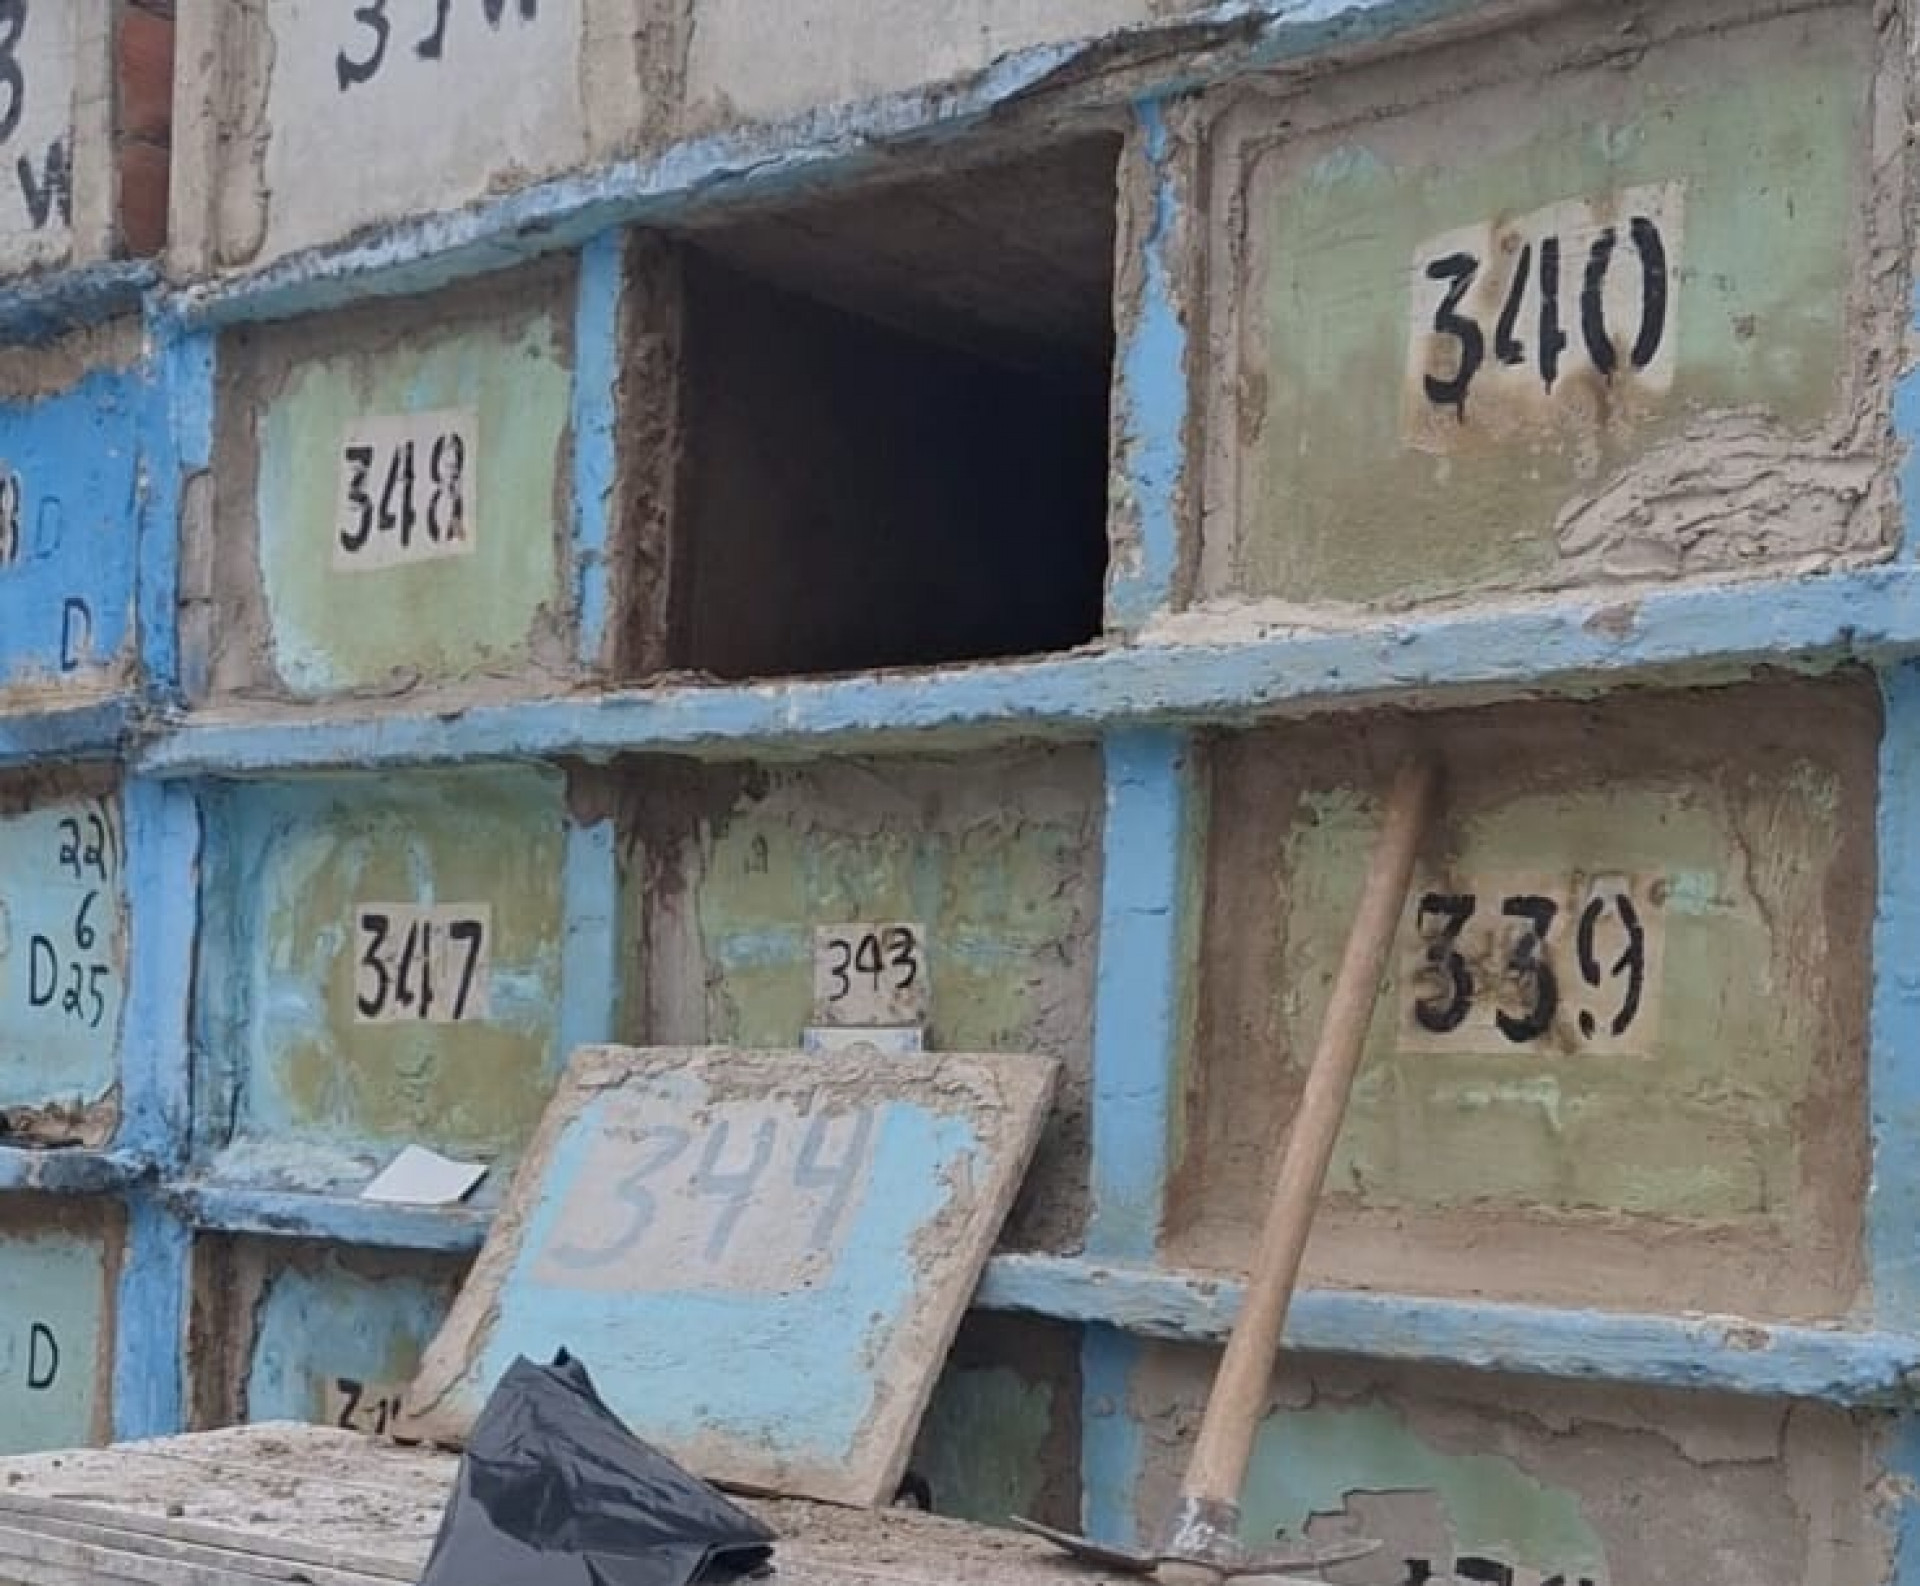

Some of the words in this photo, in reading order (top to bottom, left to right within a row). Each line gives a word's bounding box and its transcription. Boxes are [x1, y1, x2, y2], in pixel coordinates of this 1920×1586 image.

[1423, 216, 1666, 404] 340
[341, 433, 465, 551] 348
[59, 813, 107, 881] 22
[75, 891, 99, 949] 6
[358, 914, 482, 1019] 347
[828, 927, 917, 1001] 343
[1414, 893, 1645, 1043] 339
[29, 934, 58, 1006] D
[63, 962, 110, 1028] 25
[546, 1107, 876, 1270] 344
[28, 1322, 58, 1389] D
